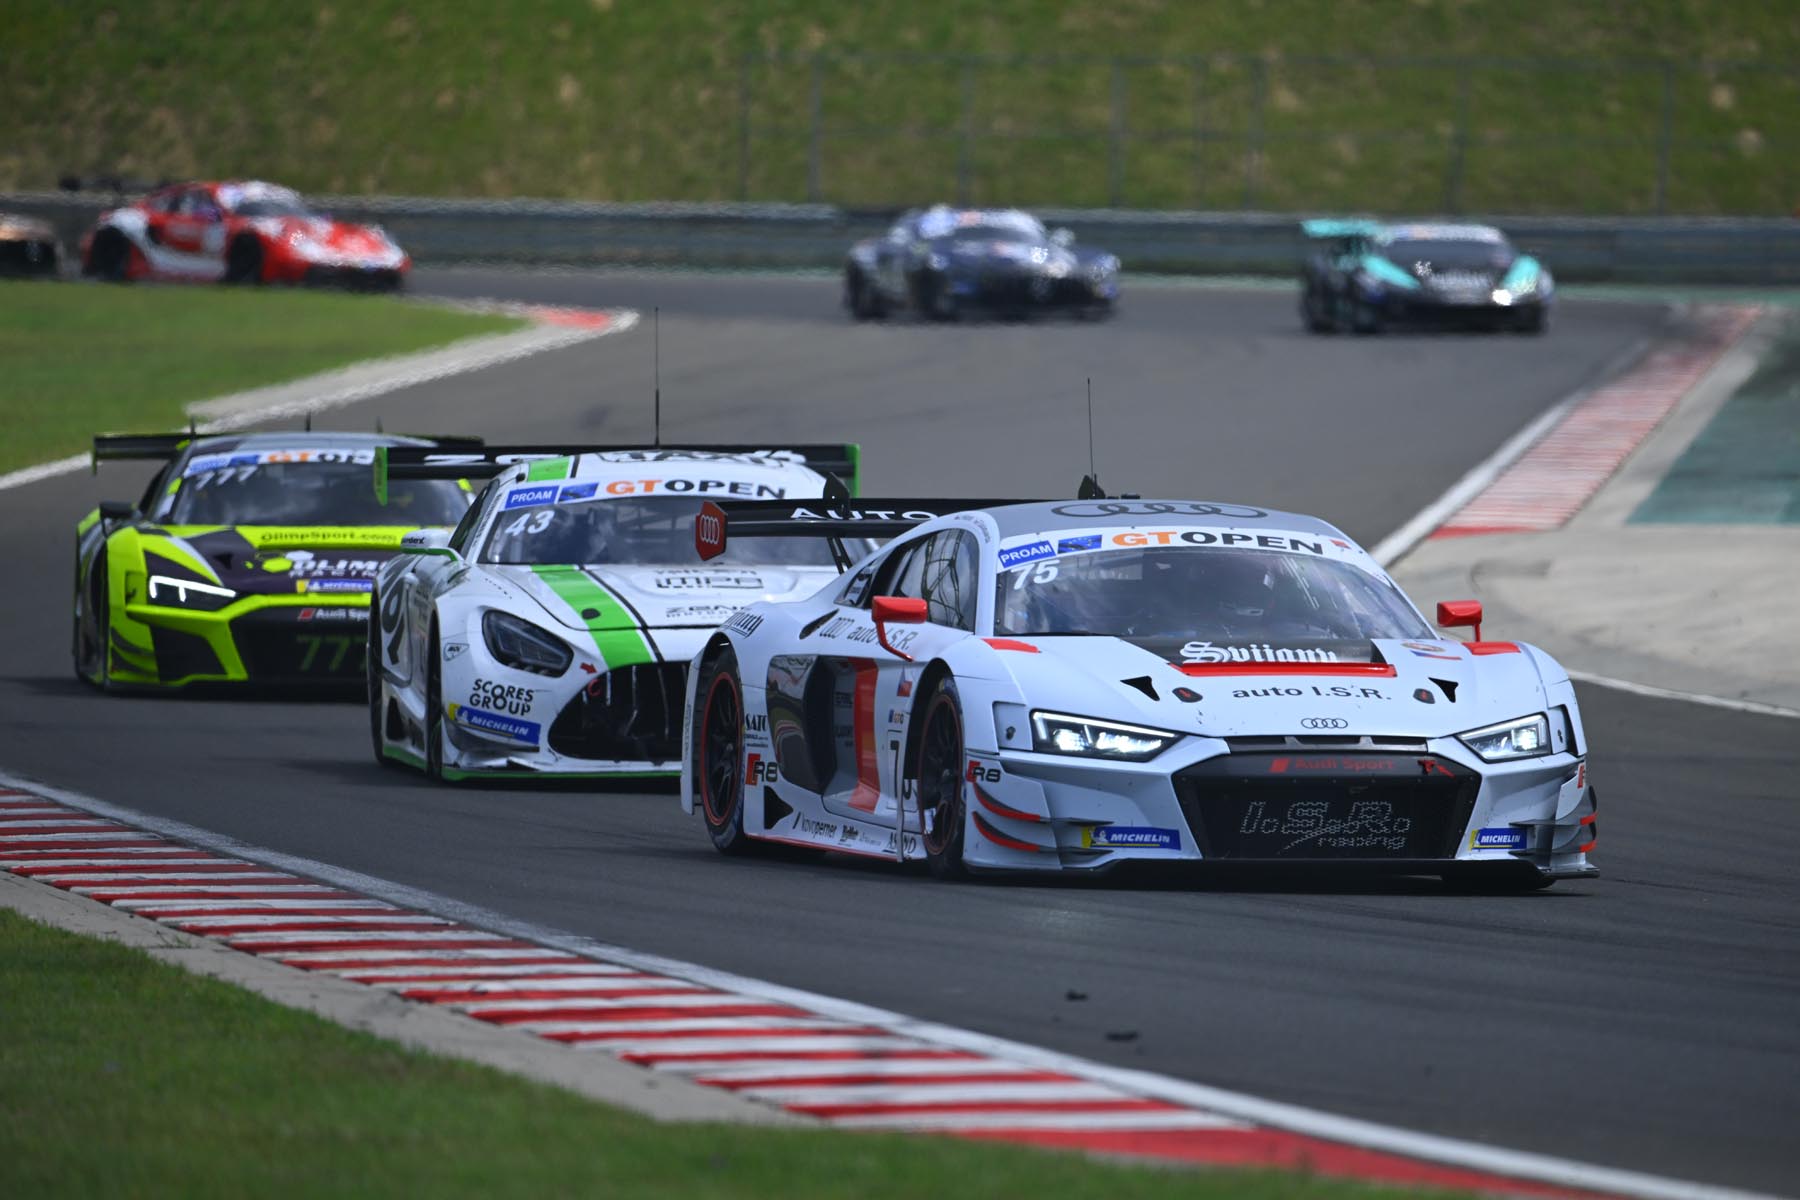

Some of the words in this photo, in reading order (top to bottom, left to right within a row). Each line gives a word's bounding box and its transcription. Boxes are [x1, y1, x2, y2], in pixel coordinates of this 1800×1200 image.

[196, 465, 258, 491] 777
[511, 490, 552, 504] PROAM
[504, 510, 555, 536] 43
[790, 506, 940, 521] AUTO
[1001, 544, 1052, 563] PROAM
[1010, 559, 1060, 590] 75
[472, 679, 534, 702] SCORES
[1232, 686, 1303, 698] auto
[1311, 686, 1392, 700] I.S.R.
[469, 693, 531, 716] GROUP
[471, 716, 529, 736] MICHELIN
[752, 761, 778, 782] R8
[973, 766, 1001, 783] R8
[1296, 759, 1337, 769] Audi
[1342, 759, 1393, 771] Sport
[1239, 801, 1411, 833] I.S.R.
[1110, 833, 1170, 843] MICHELIN
[1318, 835, 1406, 850] racing
[1481, 835, 1520, 843] MICHELIN
